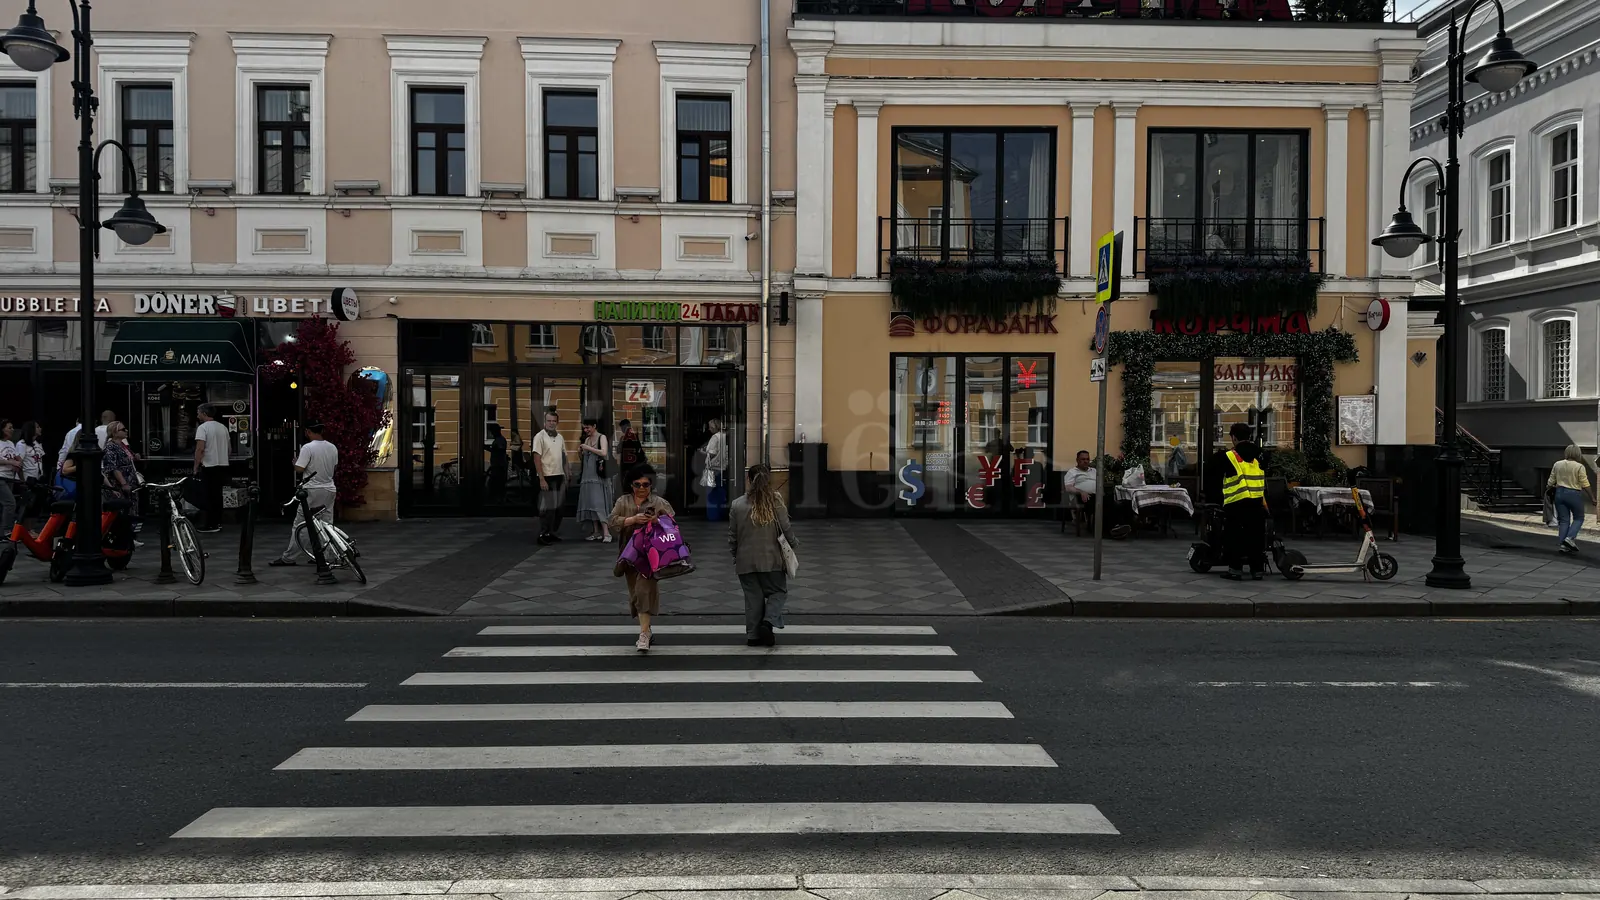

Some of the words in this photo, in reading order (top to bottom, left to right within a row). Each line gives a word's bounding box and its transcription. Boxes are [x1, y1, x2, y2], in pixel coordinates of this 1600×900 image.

[73, 297, 111, 312] TA
[594, 301, 679, 320] НАПИТКИ
[682, 304, 700, 318] 24
[702, 303, 759, 321] ТАБАК
[114, 354, 158, 365] DONER
[179, 354, 222, 364] MANIA
[629, 383, 651, 402] 24
[659, 533, 676, 543] WB
